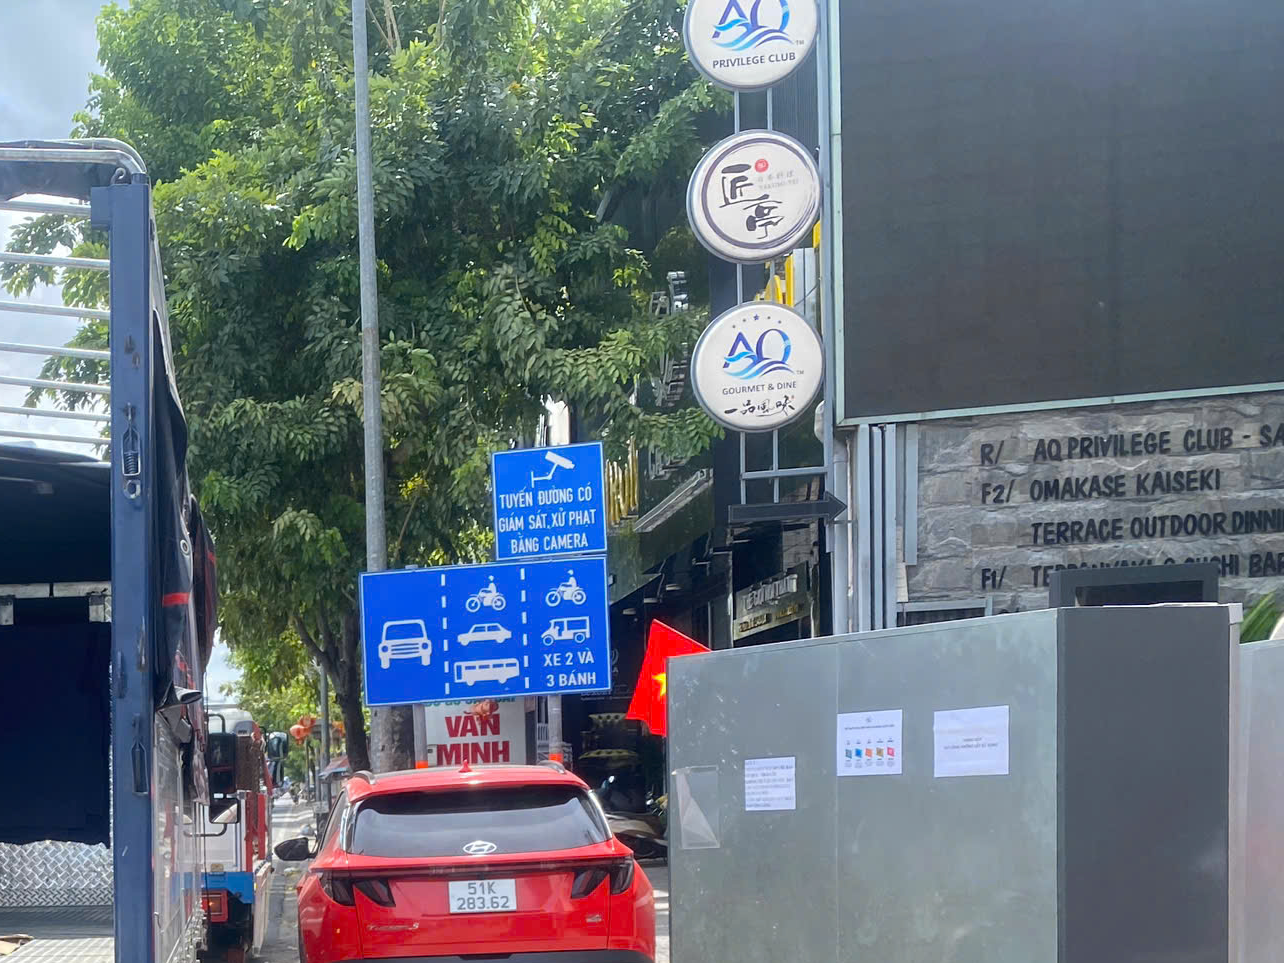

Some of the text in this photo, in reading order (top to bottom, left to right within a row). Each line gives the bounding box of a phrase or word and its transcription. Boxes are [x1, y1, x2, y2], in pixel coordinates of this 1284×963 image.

[712, 52, 796, 69] PRIVILEGE CLUB
[722, 381, 797, 396] GOURMET & DINE
[980, 440, 1005, 465] R/
[1033, 438, 1062, 462] AQ
[1067, 430, 1171, 459] PRIVILEGE
[1183, 427, 1233, 451] CLUB
[499, 486, 533, 509] TUYẾN
[578, 482, 592, 502] CÓ
[981, 468, 1220, 504] F2/ OMAKASE KAISEKI
[498, 512, 524, 532] GIÁM
[552, 507, 566, 527] XỬ
[569, 509, 597, 528] PHẠT
[1031, 508, 1284, 545] TERRACE OUTDOOR DINNI
[511, 532, 588, 554] BẰNG CAMERA
[543, 647, 594, 666] XE 2 VÀ
[546, 670, 596, 687] 3 BÁNH
[437, 740, 510, 766] MINH
[468, 881, 496, 895] 51K
[456, 896, 510, 911] 283.62
